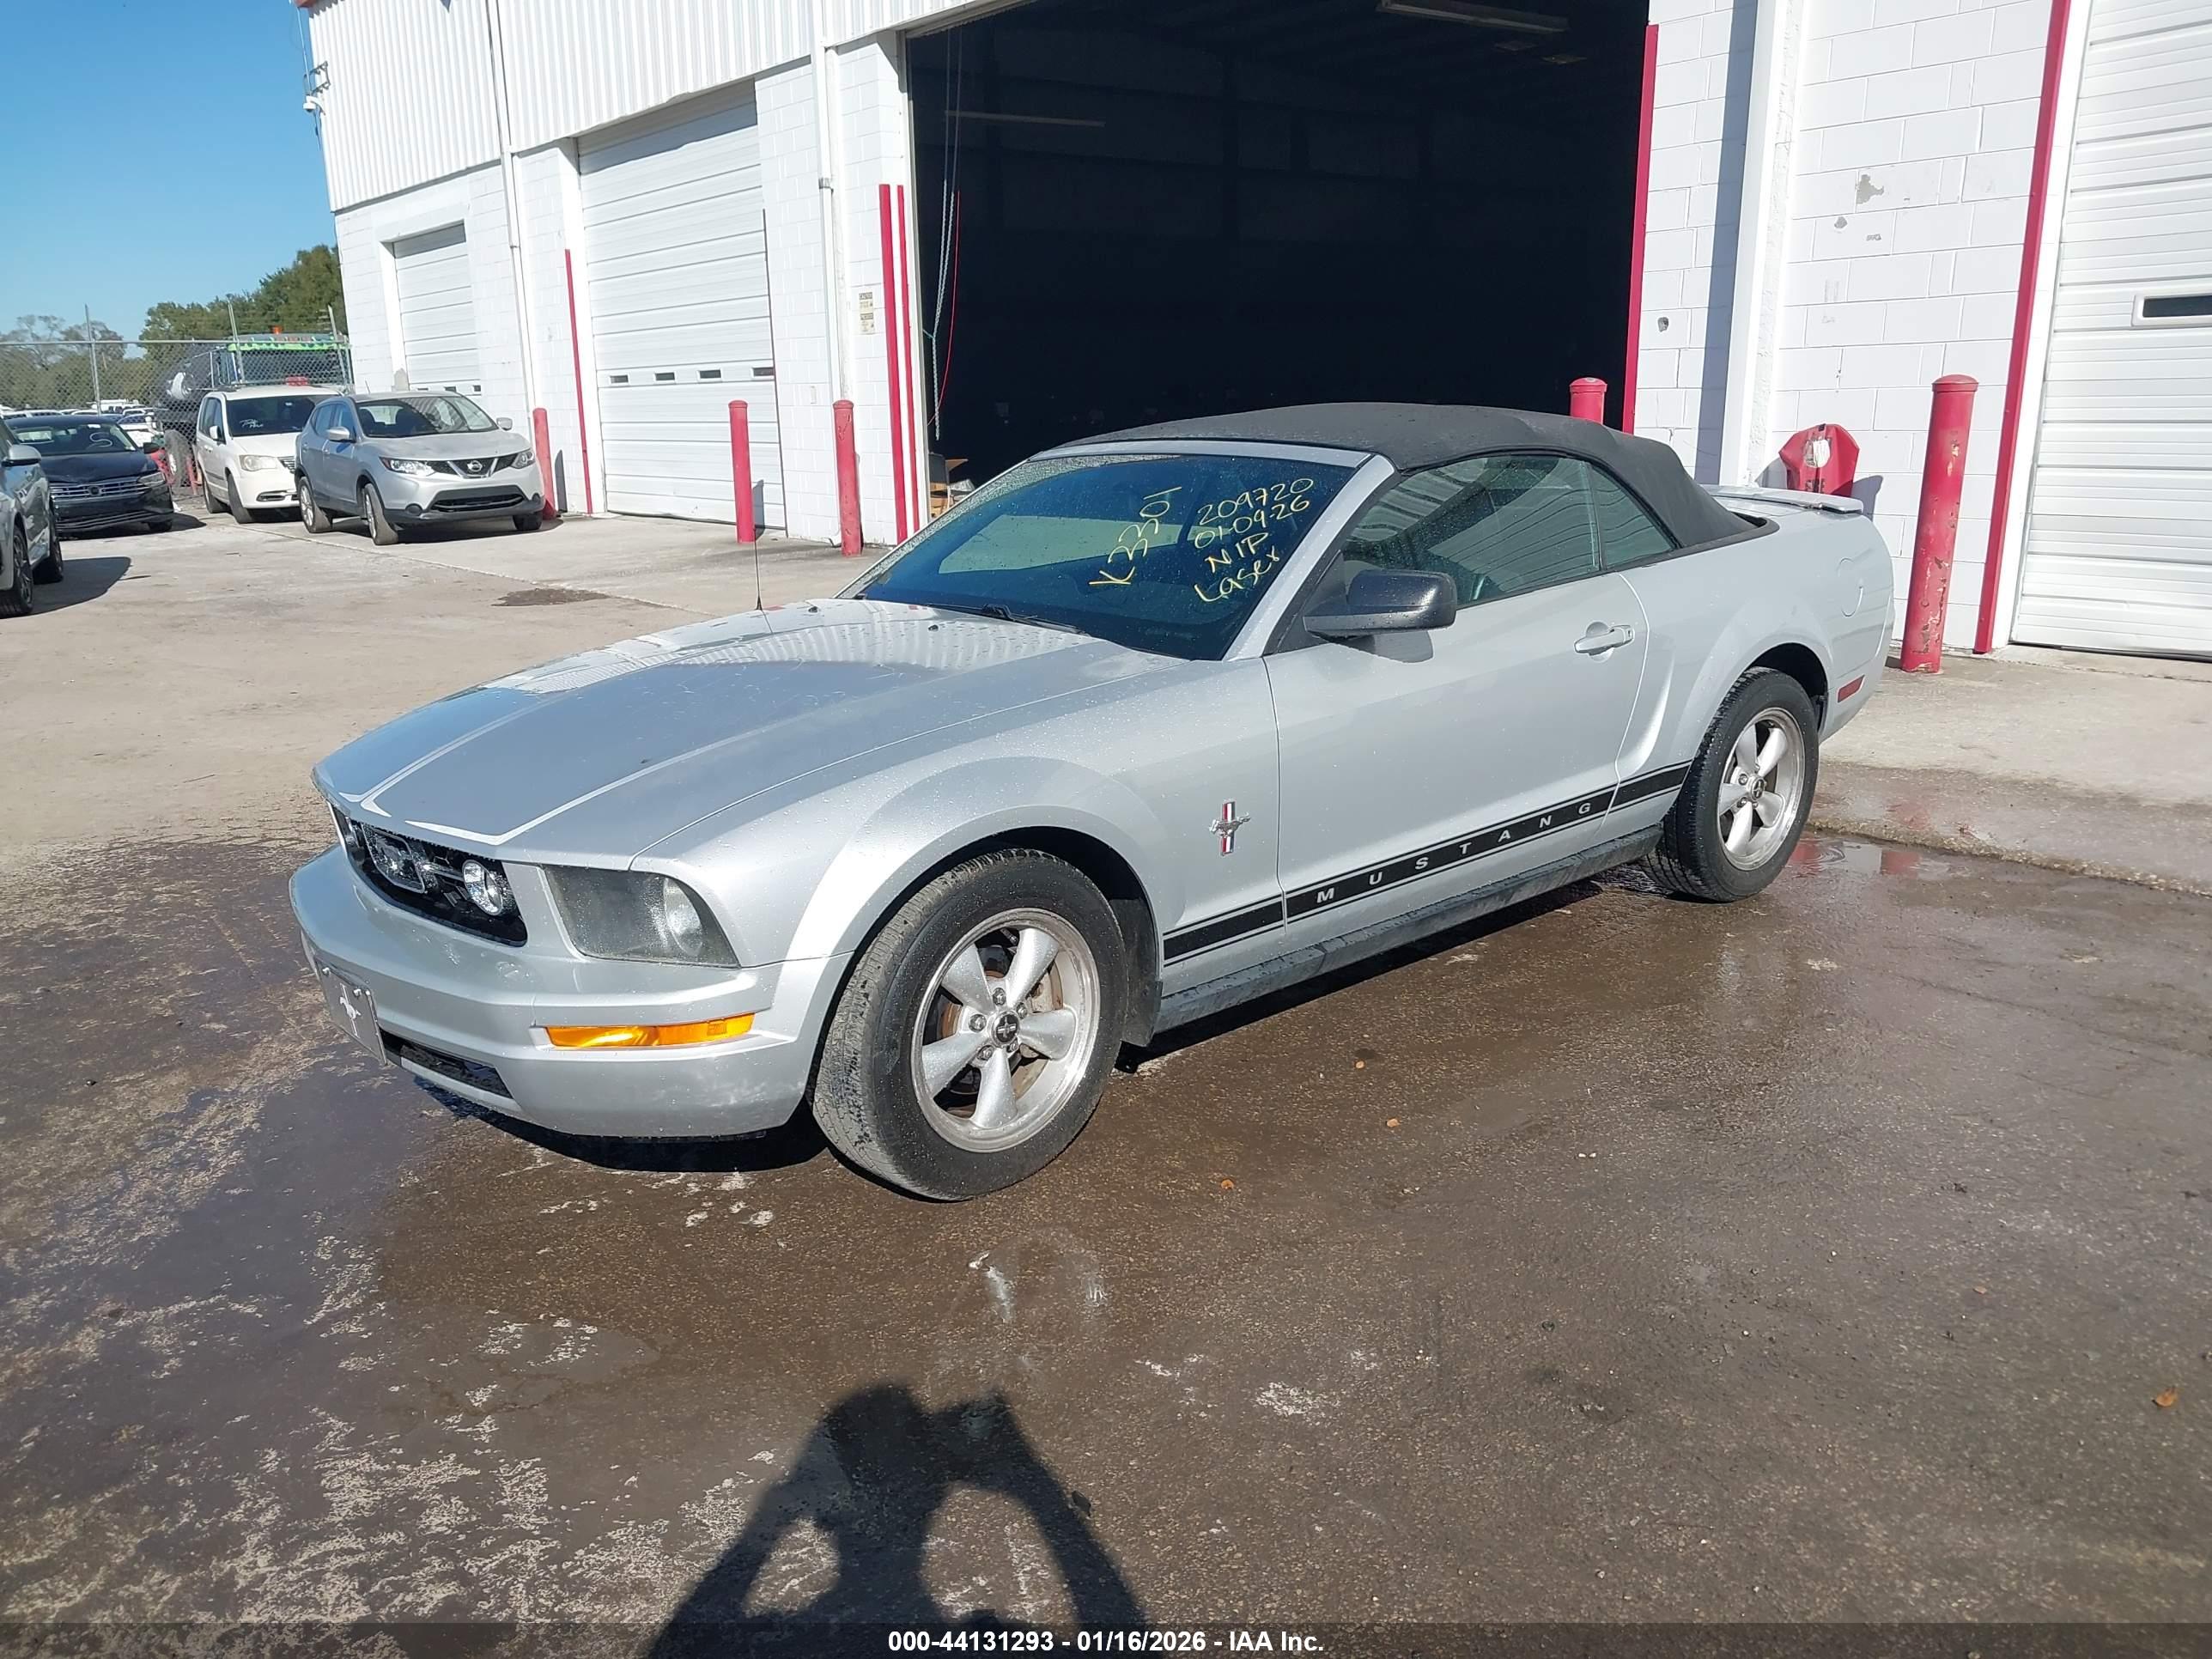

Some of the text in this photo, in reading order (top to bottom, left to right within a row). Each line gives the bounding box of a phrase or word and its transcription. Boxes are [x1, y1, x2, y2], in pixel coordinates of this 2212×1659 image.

[1194, 495, 1310, 549] 01-09-26
[1197, 477, 1314, 526] 209720
[1316, 802, 1592, 903] MUSTANG
